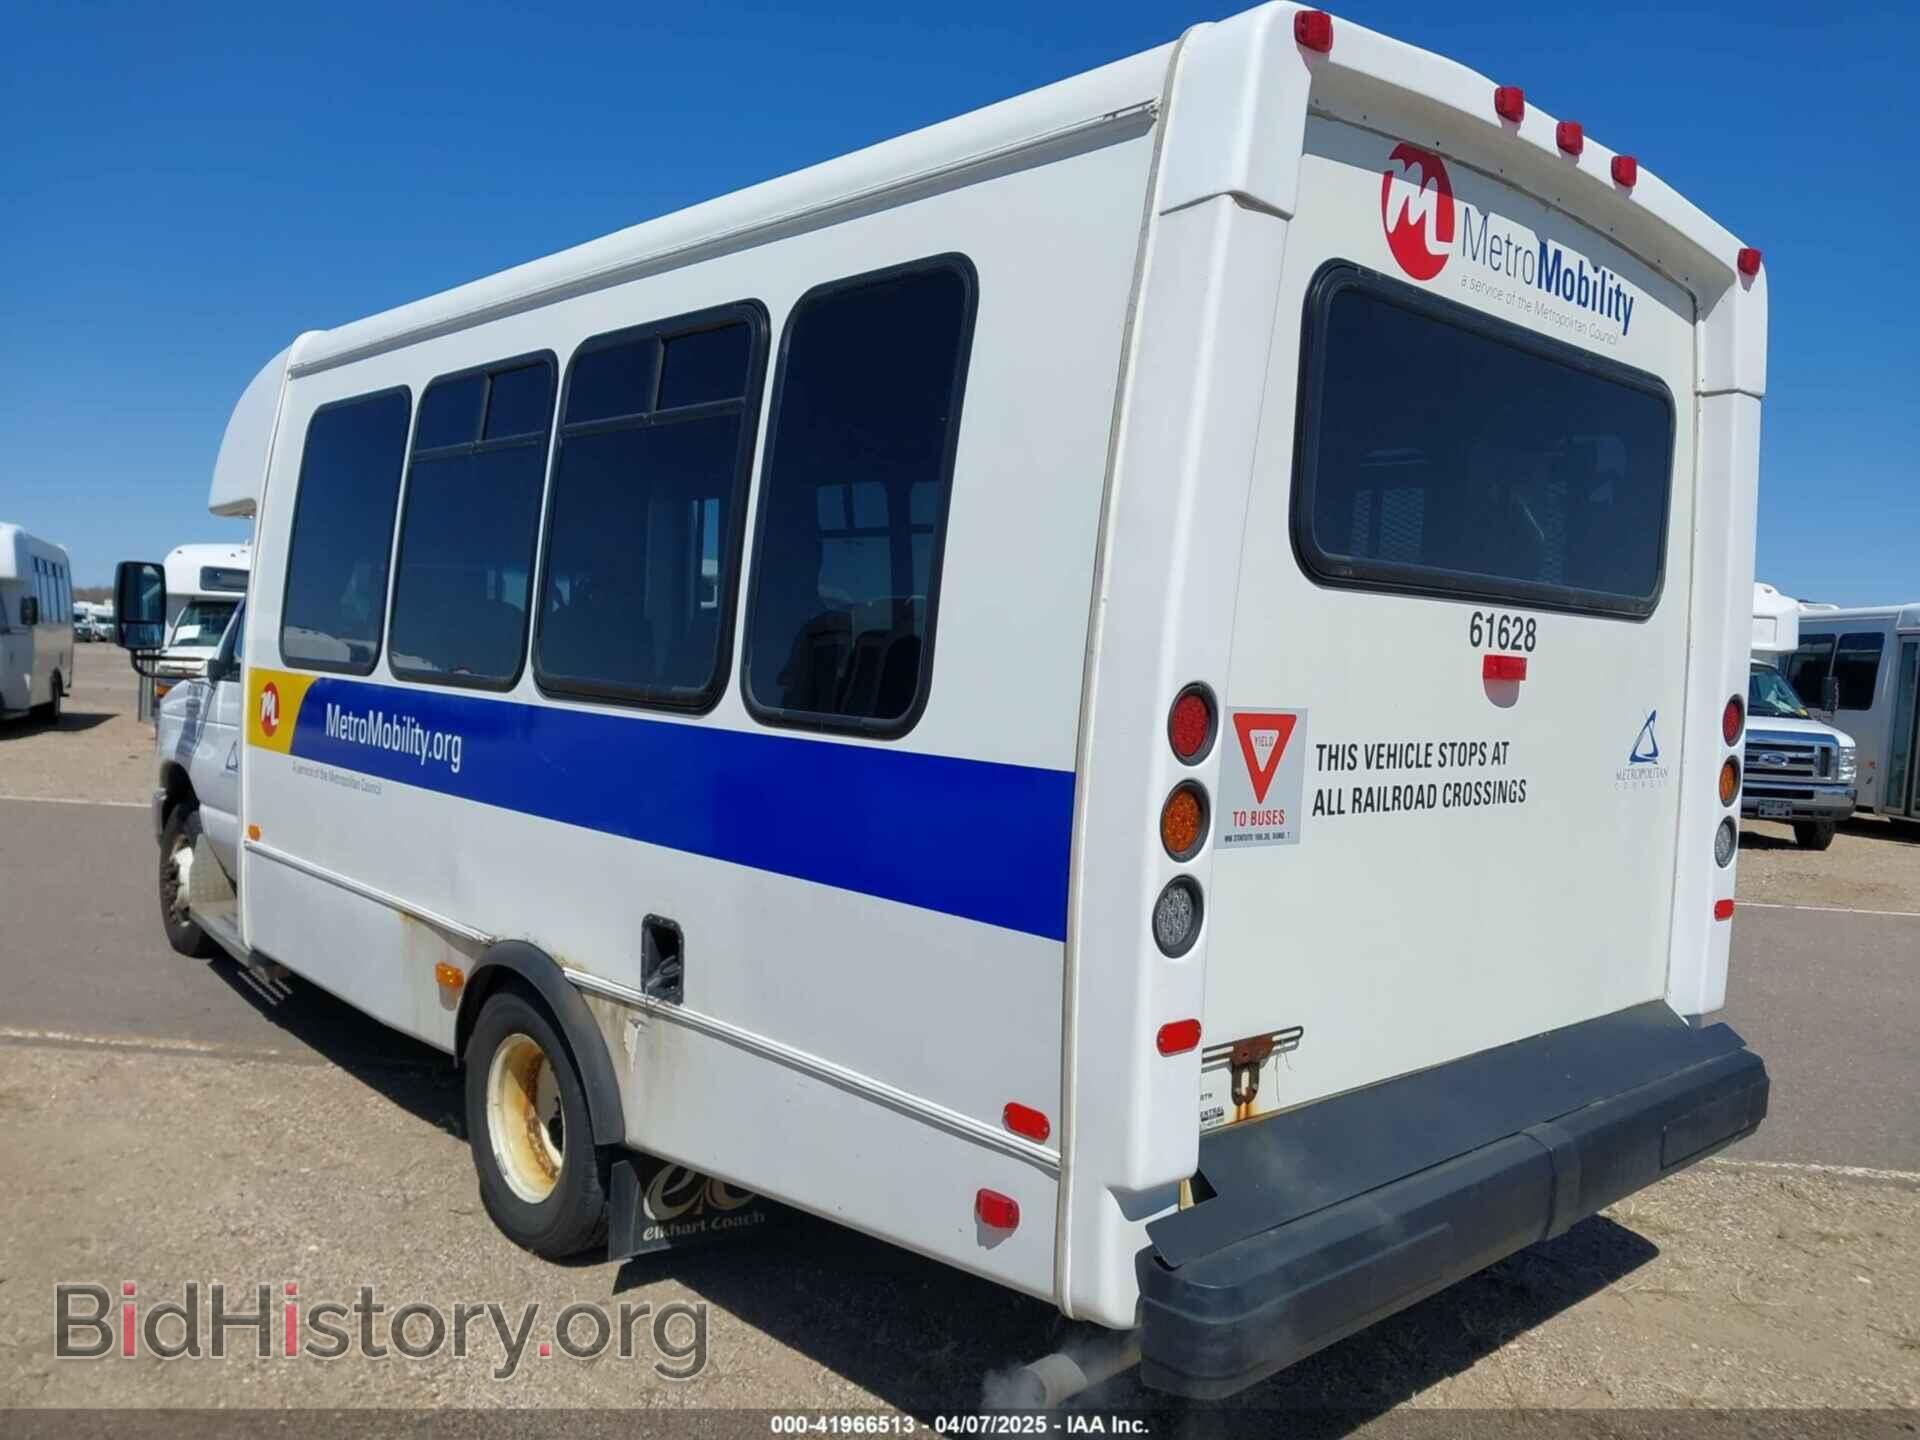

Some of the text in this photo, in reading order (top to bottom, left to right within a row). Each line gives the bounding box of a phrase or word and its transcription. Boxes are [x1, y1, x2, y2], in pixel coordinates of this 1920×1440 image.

[1461, 206, 1635, 337] MetroMobility
[1469, 278, 1503, 302] service
[1506, 289, 1517, 306] of
[1517, 295, 1533, 314] the
[1534, 301, 1588, 335] Metropolitan
[1469, 611, 1537, 653] 61628
[325, 702, 463, 774] MetroMobility.org
[1254, 735, 1274, 747] YIELD
[1315, 741, 1510, 772] THIS VEHICLE STOPS AT
[1232, 808, 1286, 827] TO BUSES
[1311, 778, 1528, 817] ALL RAILROAD CROSSINGS
